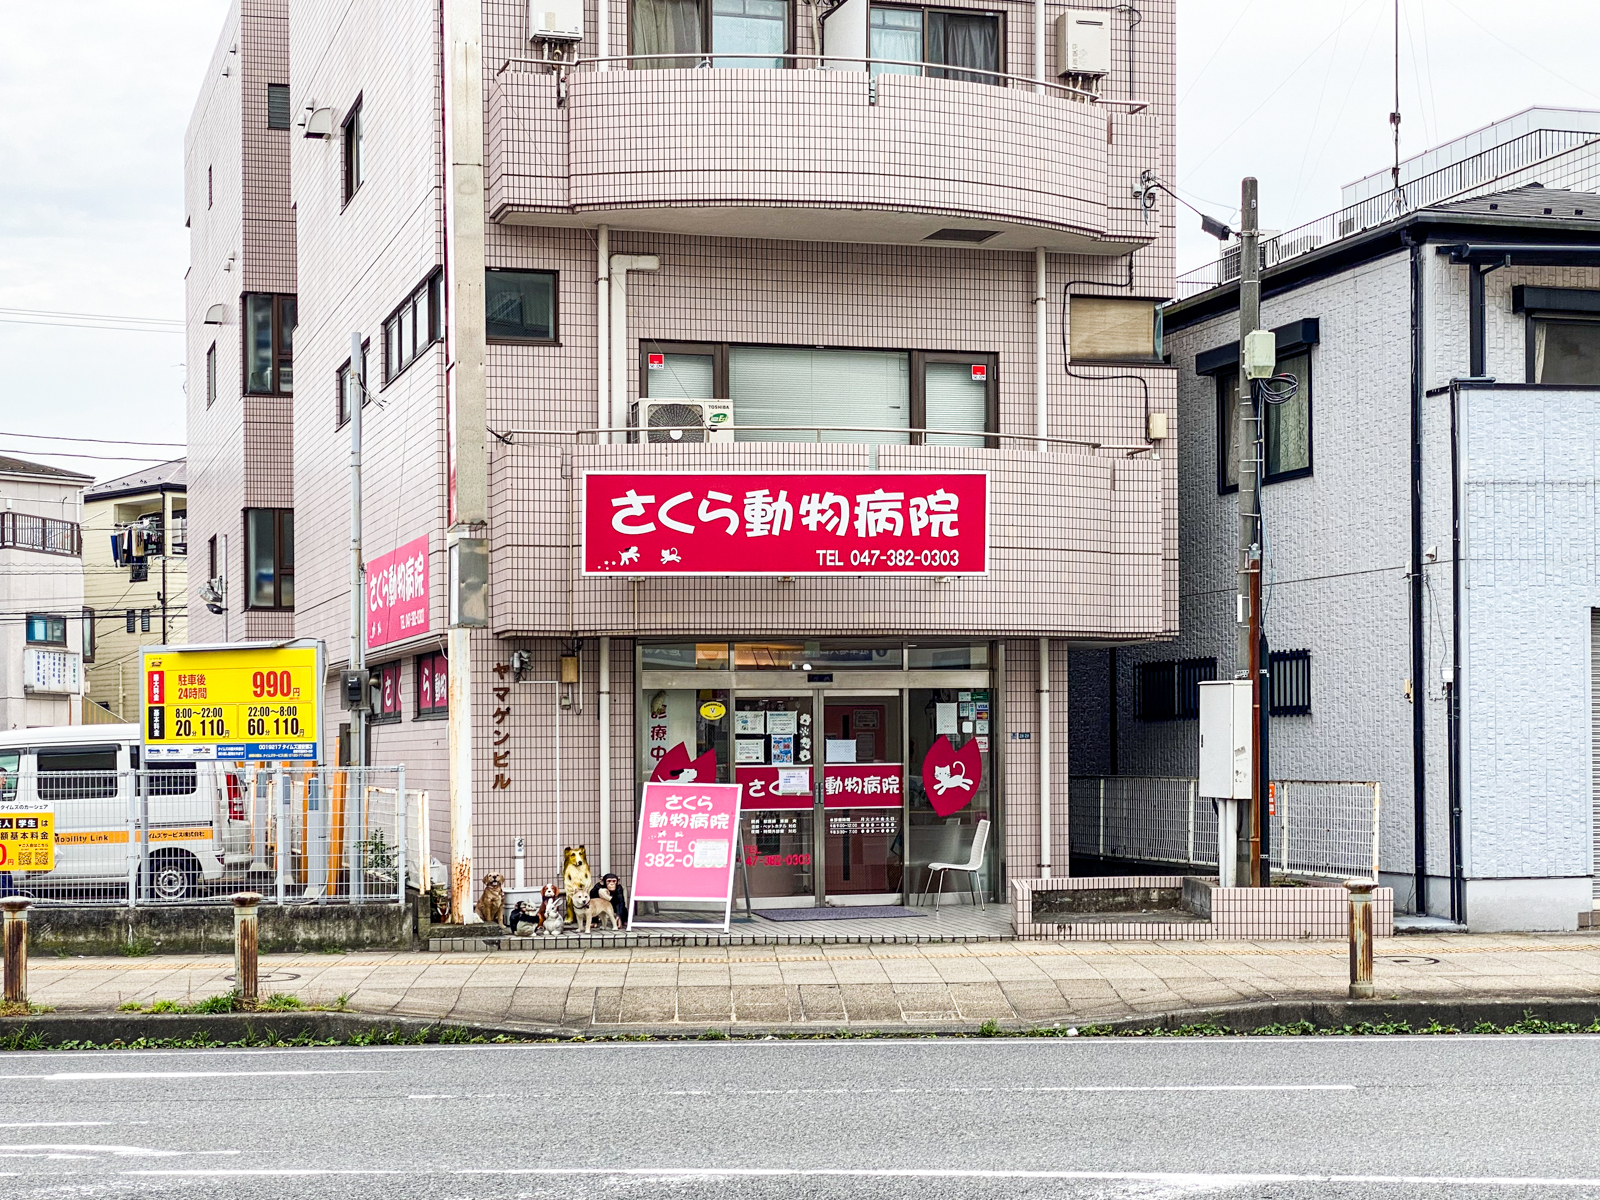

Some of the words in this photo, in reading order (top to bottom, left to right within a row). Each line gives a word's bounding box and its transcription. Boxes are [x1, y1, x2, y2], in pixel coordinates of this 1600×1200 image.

[611, 488, 960, 538] さくら動物病院
[816, 550, 844, 566] TEL
[850, 550, 960, 566] 047-382-0303
[369, 551, 424, 612] さくら動物病院
[177, 674, 206, 686] 駐車後
[252, 670, 300, 698] 990円
[177, 687, 207, 700] 24時間
[175, 720, 197, 737] 20分
[199, 719, 230, 738] 110円
[247, 718, 270, 736] 60分
[273, 718, 305, 738] 110円
[492, 662, 511, 789] ヤマゲンビル
[665, 794, 713, 811] さくら
[18, 819, 36, 828] 学生
[649, 812, 730, 829] 動物病院
[54, 836, 87, 844] Mobility
[657, 839, 682, 853] TEL
[738, 854, 811, 866] 47-382-0303
